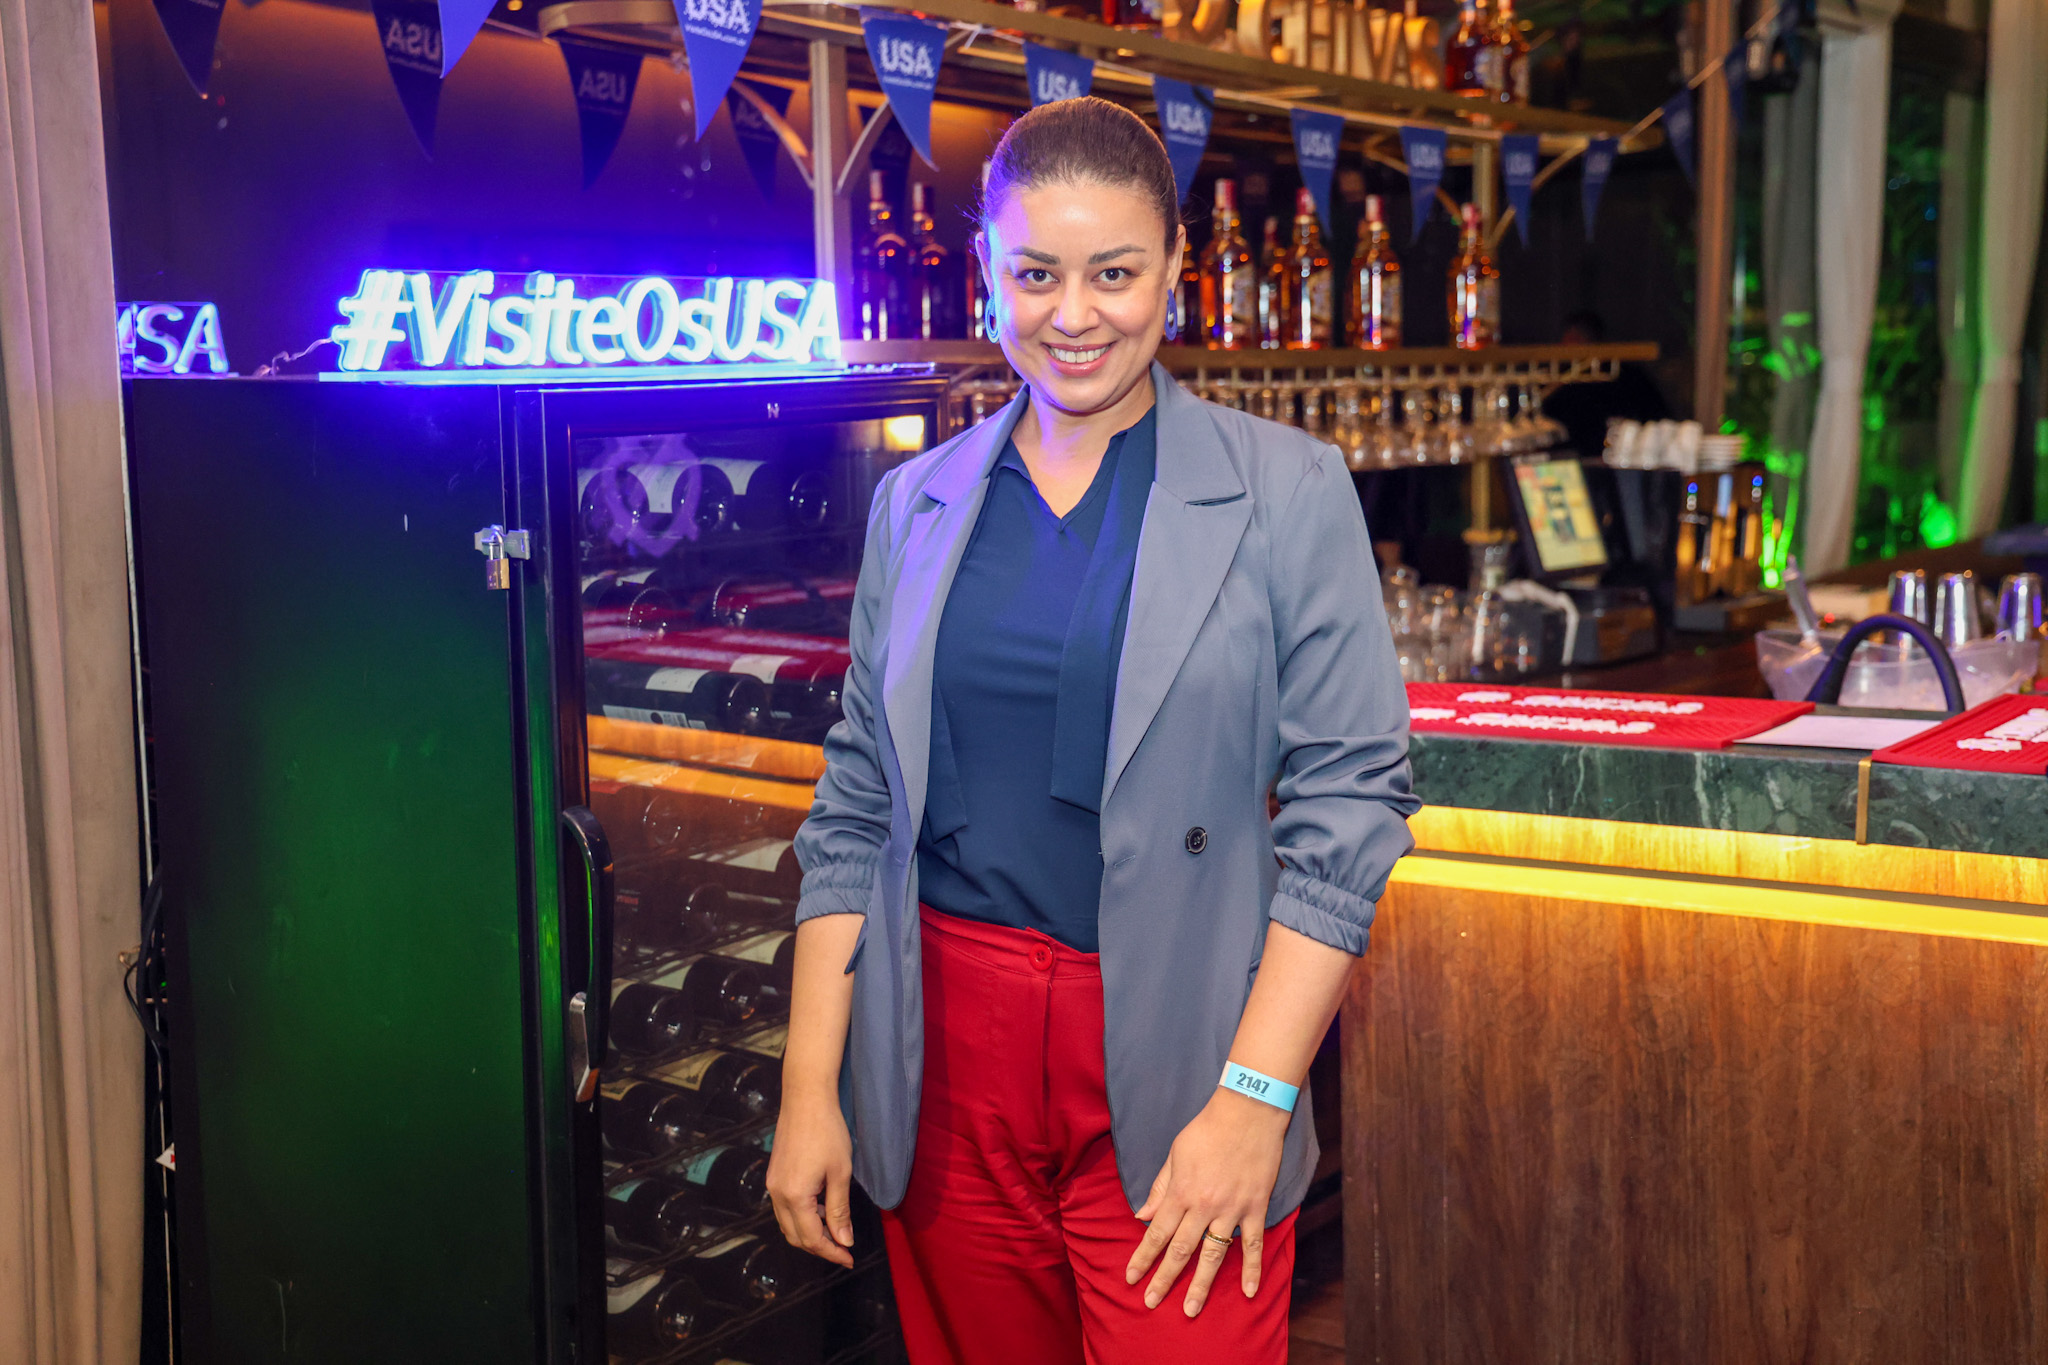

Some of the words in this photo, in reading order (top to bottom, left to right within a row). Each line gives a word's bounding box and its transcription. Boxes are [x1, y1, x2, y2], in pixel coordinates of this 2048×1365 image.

[683, 0, 751, 34] USA
[878, 35, 934, 79] USA
[1037, 67, 1082, 101] USA
[1165, 101, 1207, 137] USA
[333, 268, 842, 371] #VisiteOsUSA
[1235, 1072, 1270, 1095] 2147
